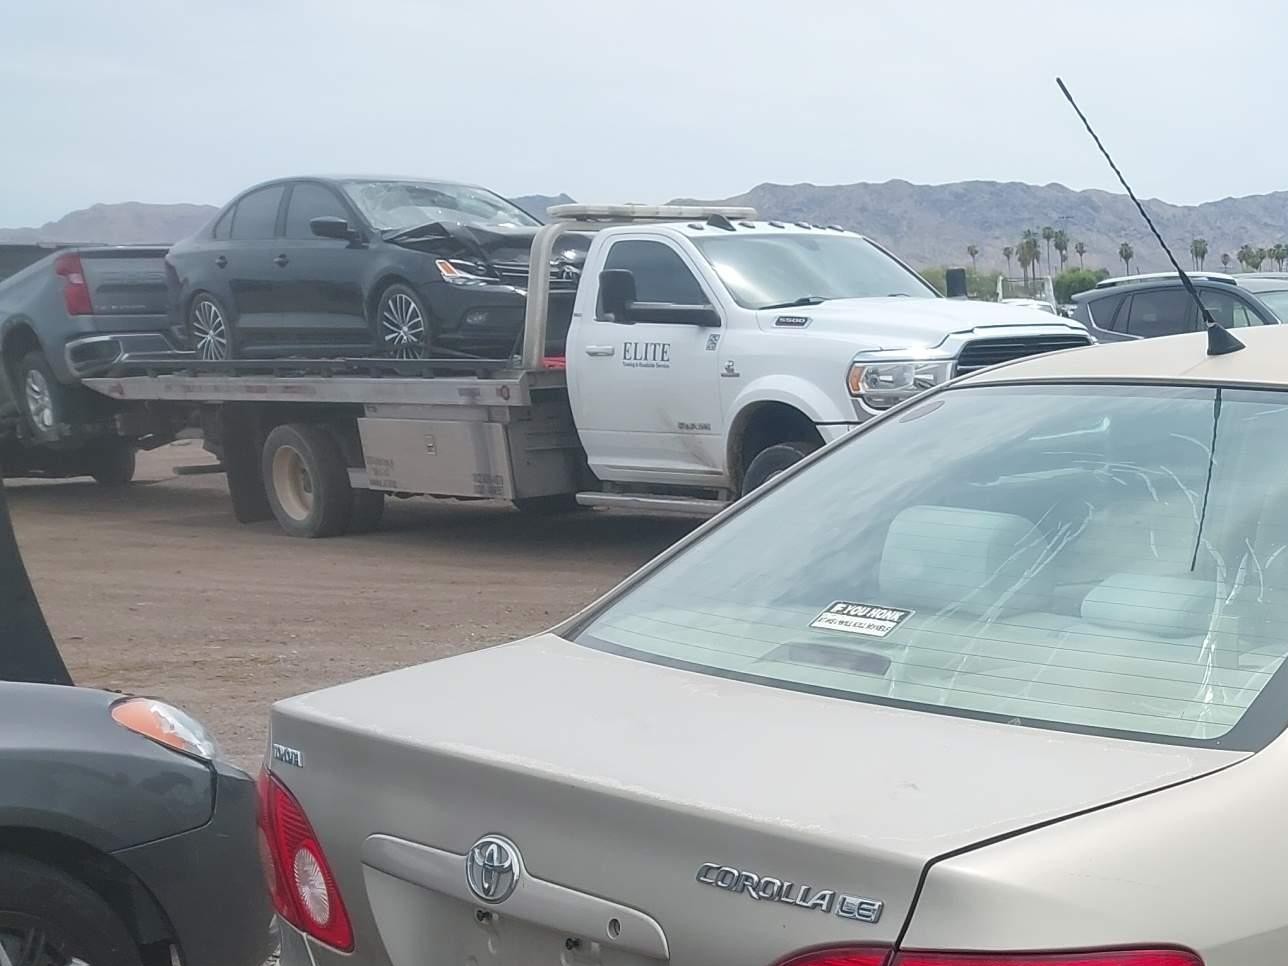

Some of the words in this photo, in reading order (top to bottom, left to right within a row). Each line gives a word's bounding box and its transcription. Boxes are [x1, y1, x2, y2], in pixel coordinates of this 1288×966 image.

[623, 342, 670, 361] ELITE
[843, 605, 868, 617] YOU
[867, 607, 905, 621] HONK
[696, 862, 835, 913] COROLLA
[838, 896, 881, 922] LE
